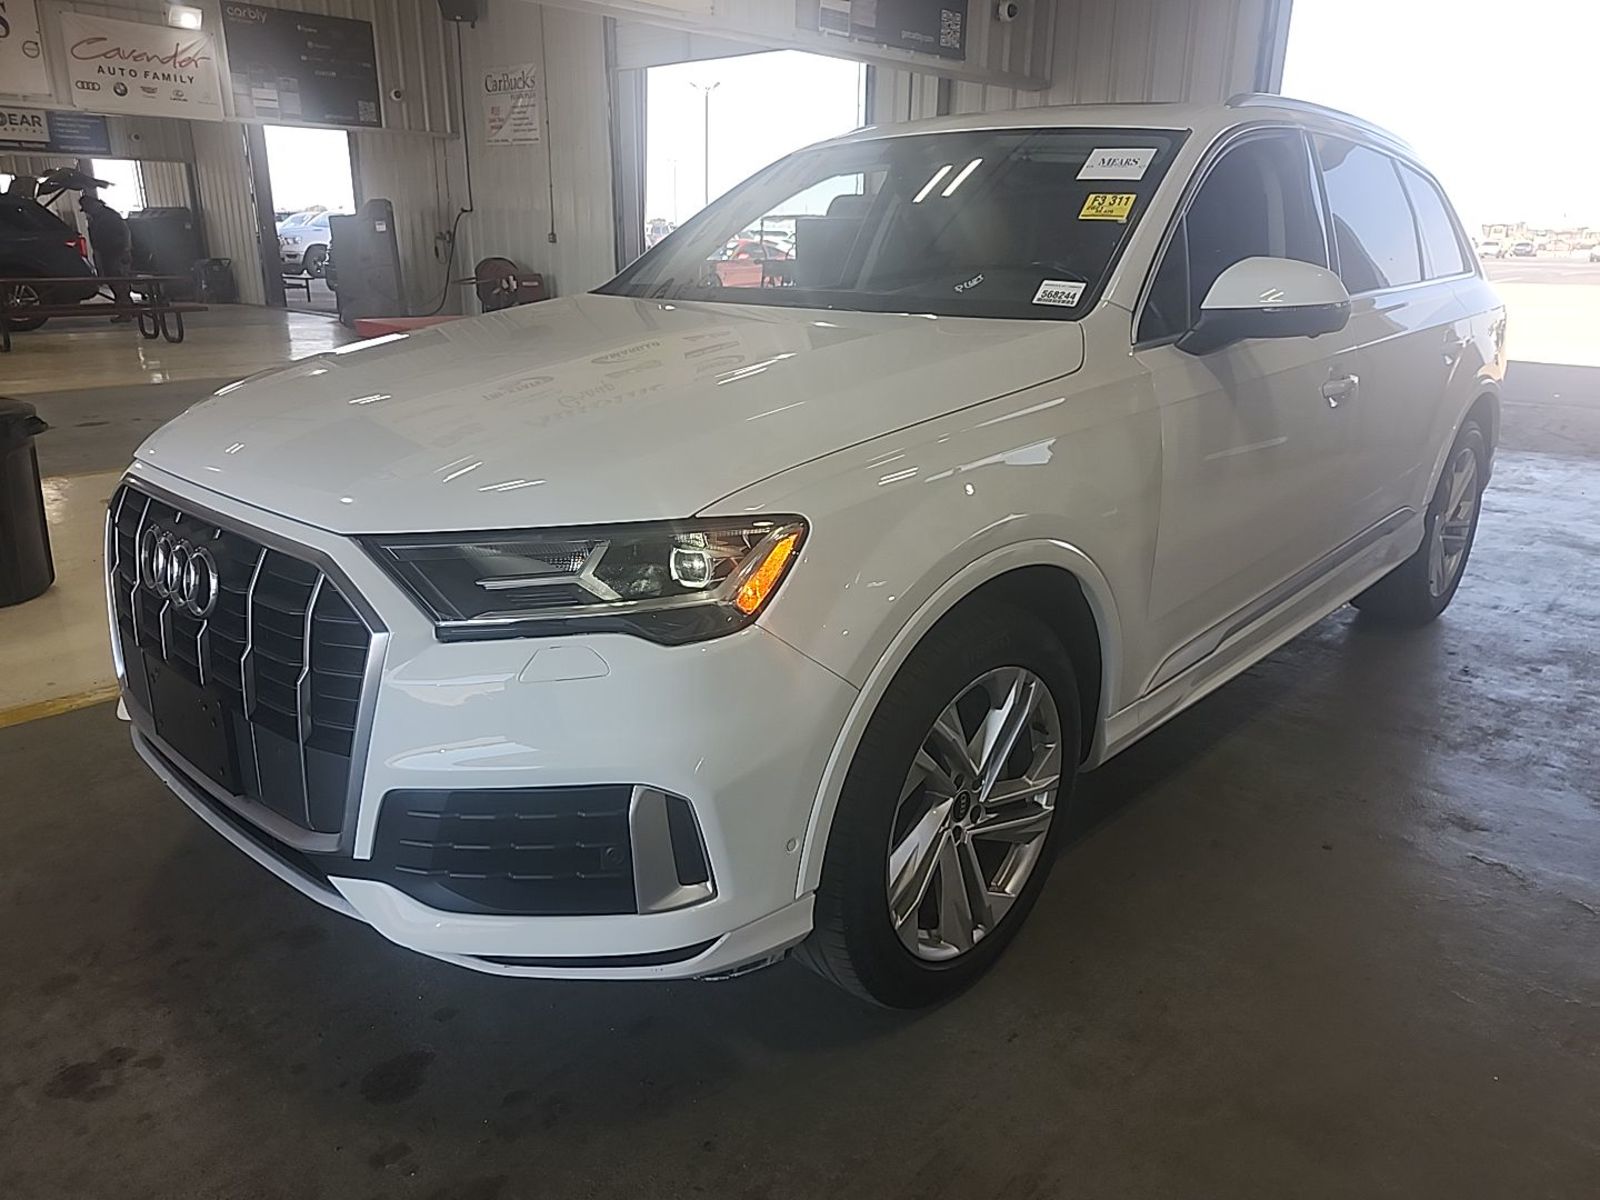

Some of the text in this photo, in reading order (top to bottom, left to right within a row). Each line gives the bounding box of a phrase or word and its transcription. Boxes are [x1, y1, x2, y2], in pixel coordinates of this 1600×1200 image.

[226, 6, 267, 24] carbly
[97, 65, 194, 84] AUTO FAMILY
[485, 70, 536, 93] CarBucks
[1098, 157, 1141, 168] MEARS
[1091, 195, 1131, 206] F3 311
[1041, 289, 1077, 300] 568244
